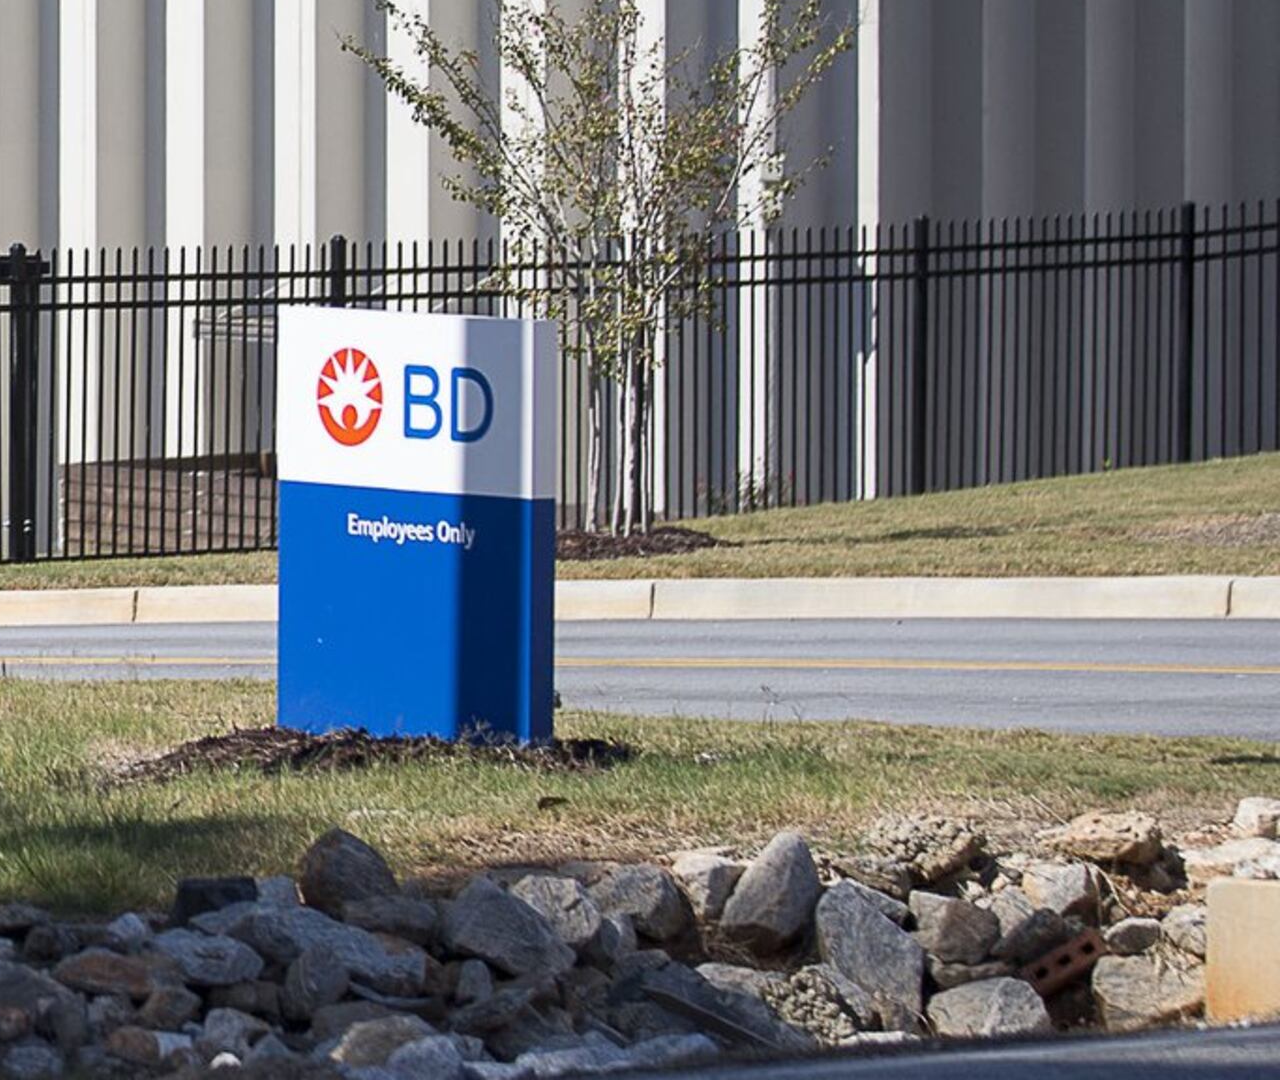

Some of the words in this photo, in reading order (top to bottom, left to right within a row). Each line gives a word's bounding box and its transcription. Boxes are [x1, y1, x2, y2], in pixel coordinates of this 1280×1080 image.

[404, 364, 493, 443] BD
[347, 513, 434, 544] Employees
[437, 520, 475, 549] Only
